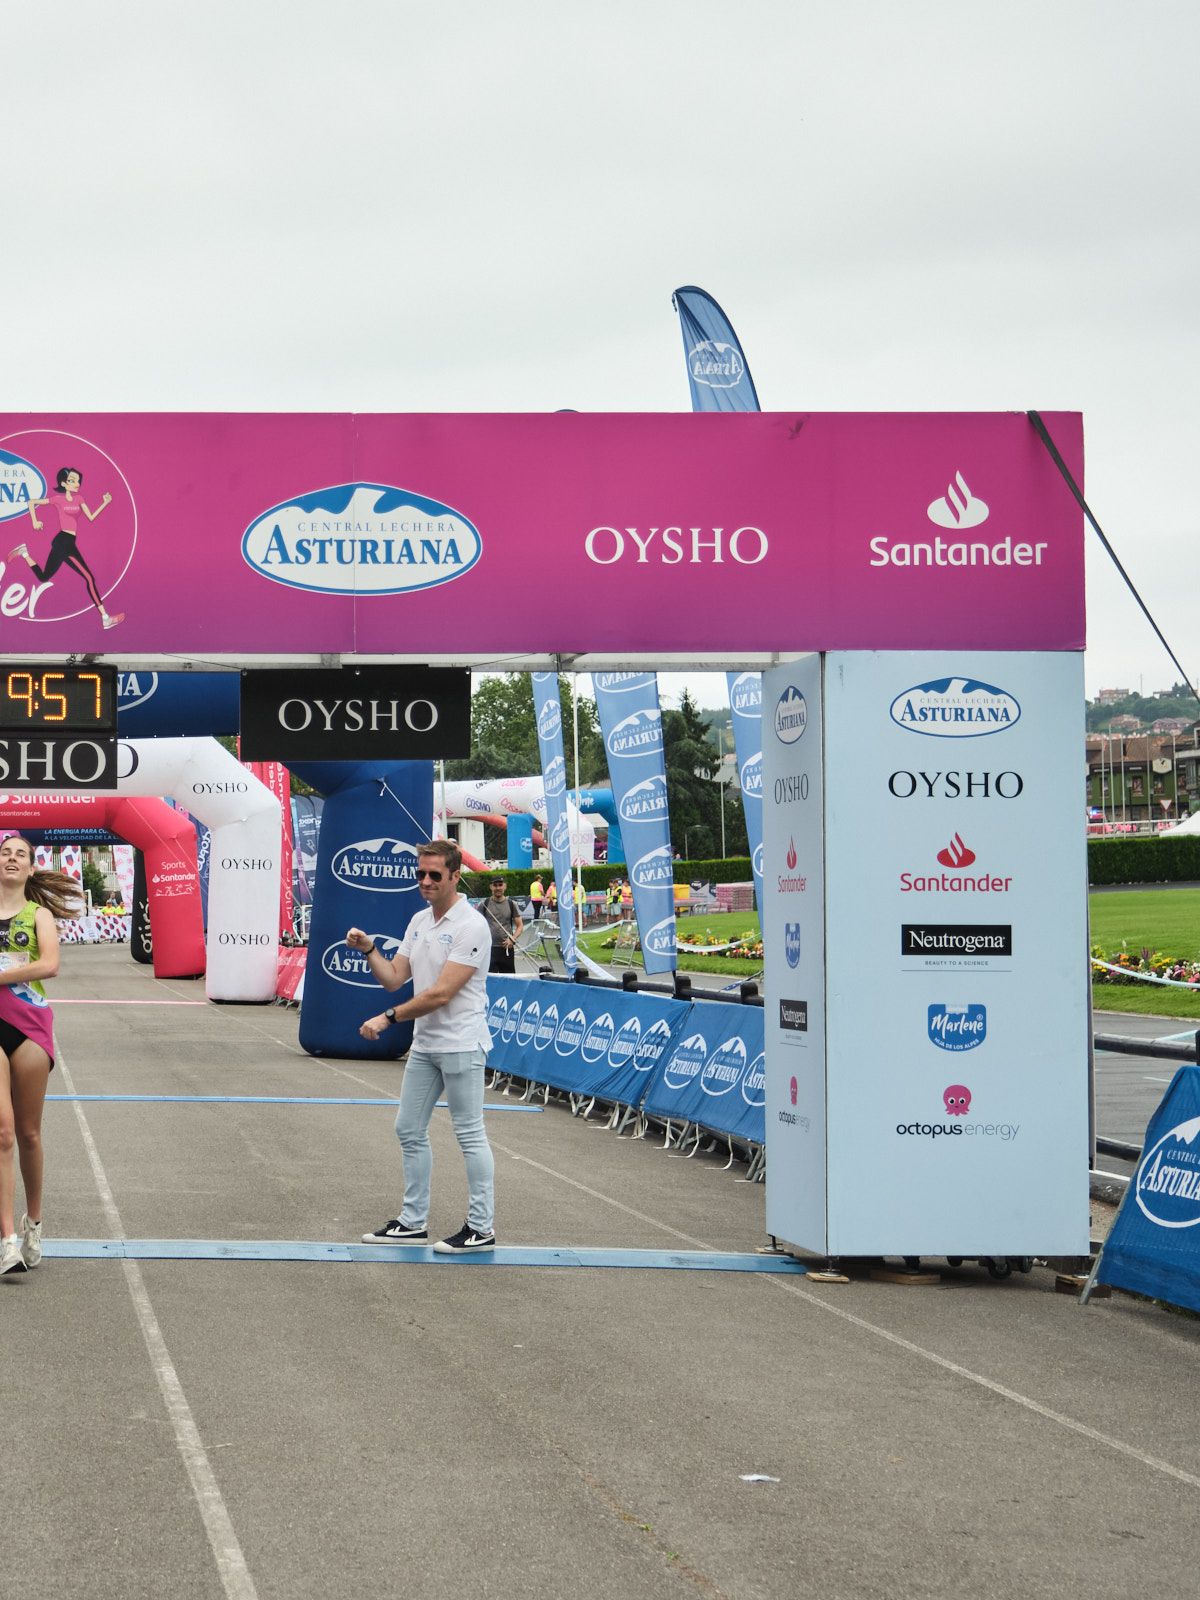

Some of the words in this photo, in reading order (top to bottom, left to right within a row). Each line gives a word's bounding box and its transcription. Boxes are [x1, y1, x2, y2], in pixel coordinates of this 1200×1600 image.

[297, 521, 372, 532] CENTRAL
[380, 522, 456, 533] LECHERA
[260, 524, 463, 565] ASTURIANA
[584, 526, 770, 564] OYSHO
[869, 536, 1048, 567] Santander
[899, 699, 1011, 722] ASTURIANA
[919, 697, 961, 705] CENTRAL
[278, 698, 439, 732] OYSHO
[777, 711, 805, 731] ASTURIANA
[192, 782, 248, 794] OYSHO
[774, 773, 809, 805] OYSHO
[888, 770, 1024, 799] OYSHO
[465, 797, 491, 812] COSMO
[161, 861, 186, 870] Sports
[221, 858, 273, 871] OYSHO
[337, 854, 419, 879] ASTURIAN
[354, 854, 391, 862] CENTRAL
[393, 856, 418, 864] LECHE
[161, 873, 196, 882] Santander
[778, 874, 807, 893] Santander
[899, 872, 1013, 892] Santander
[218, 933, 270, 946] OYSHO
[908, 930, 1005, 952] Neutrogena
[781, 1005, 806, 1027] Neutrogena
[931, 1014, 984, 1039] Marlene
[896, 1122, 963, 1139] octopus
[964, 1124, 1020, 1141] energy
